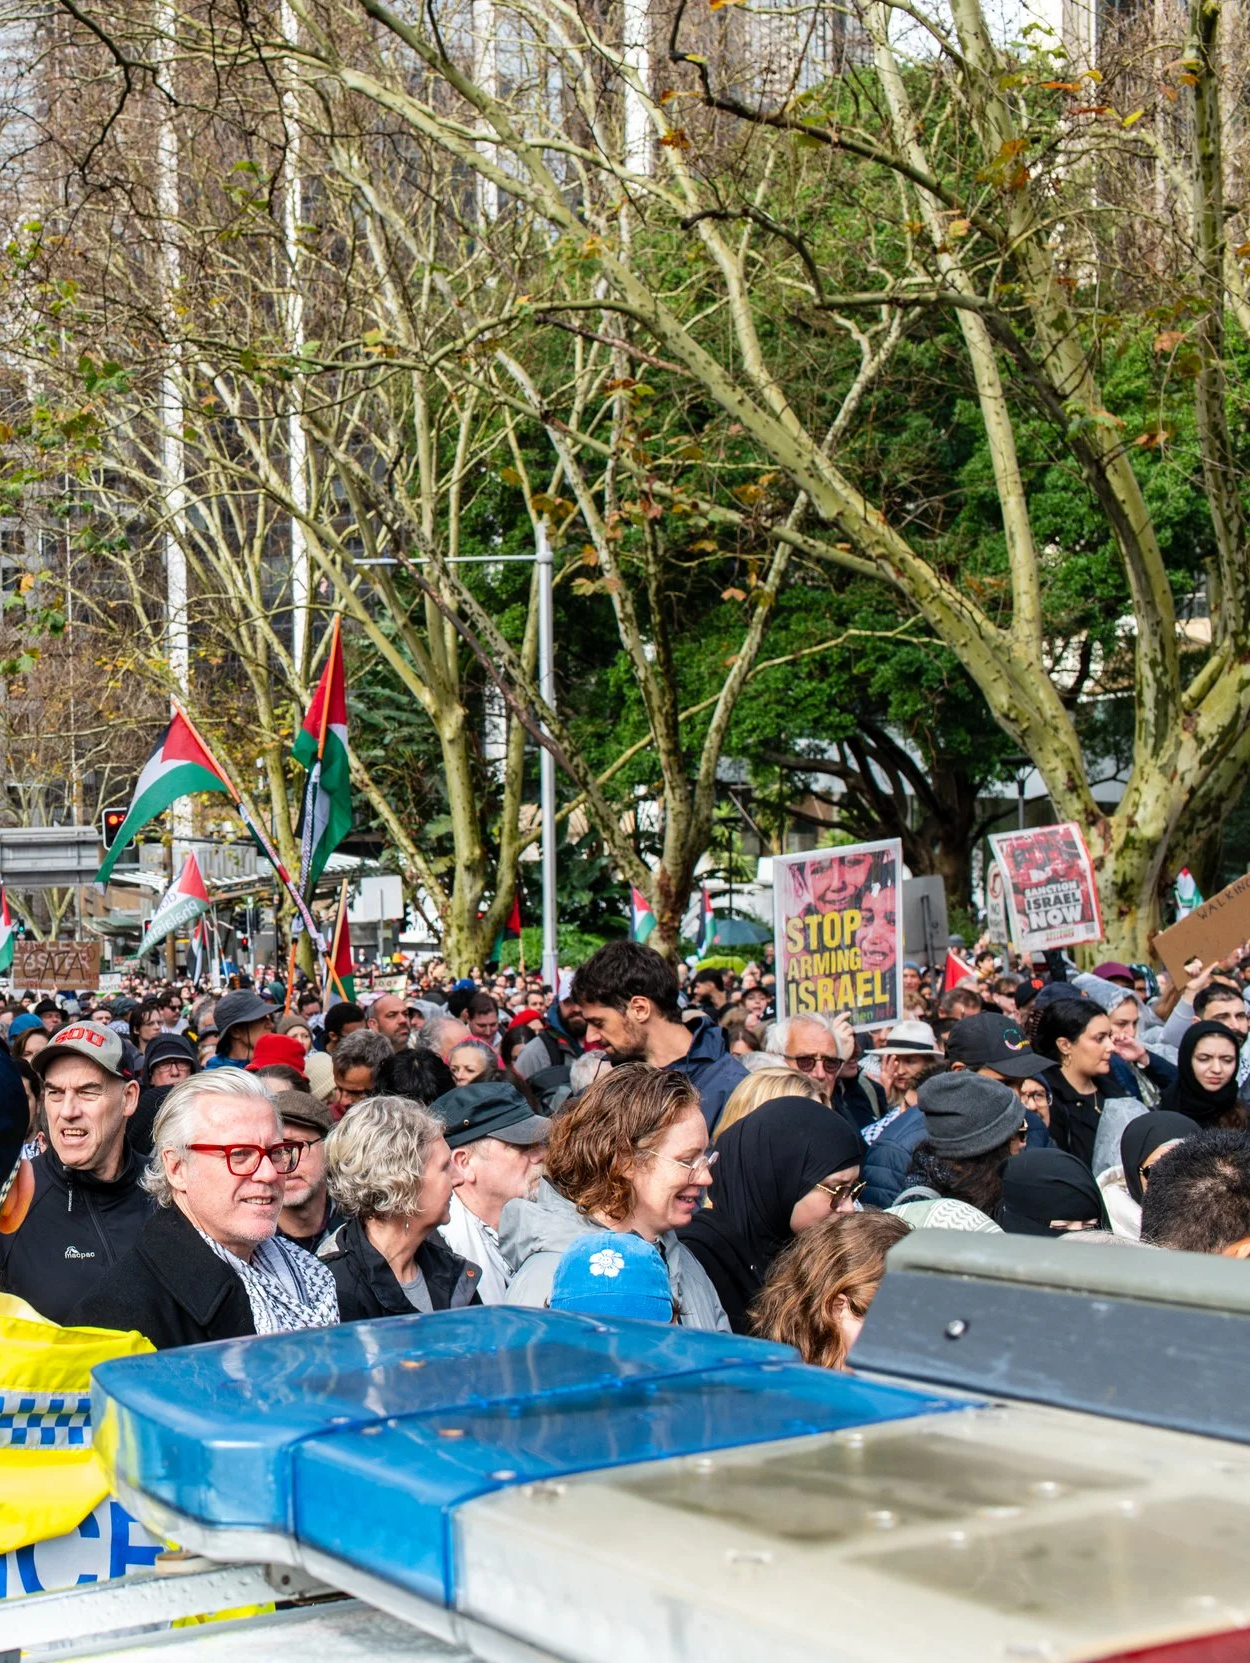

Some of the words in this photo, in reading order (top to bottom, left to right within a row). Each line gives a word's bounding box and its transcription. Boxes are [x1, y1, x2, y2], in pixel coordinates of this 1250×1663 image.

[1024, 881, 1077, 897] SANCTION
[1026, 891, 1080, 910] ISRAEL
[786, 908, 863, 954] STOP
[1029, 905, 1083, 930] NOW
[23, 948, 85, 983] GAZA
[787, 946, 862, 981] ARMING
[788, 968, 890, 1017] ISRAEL
